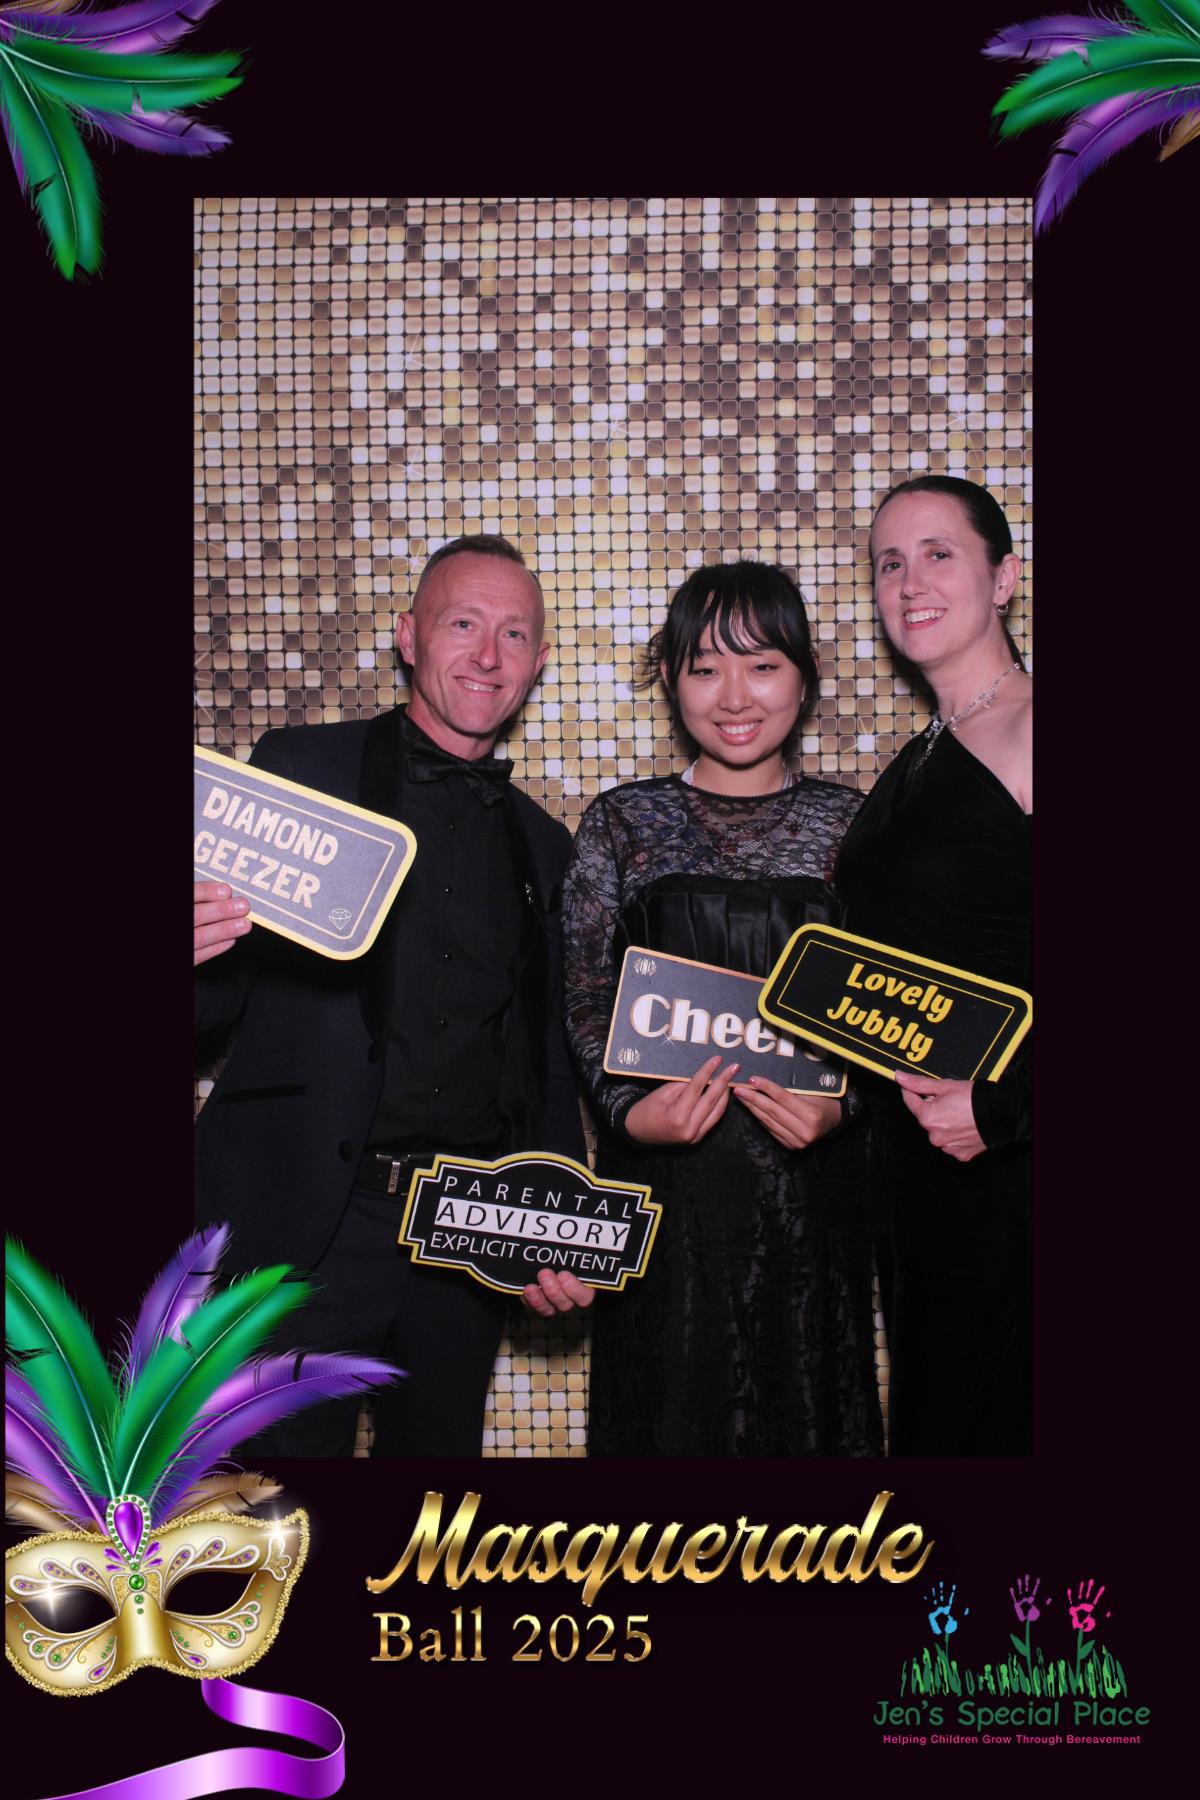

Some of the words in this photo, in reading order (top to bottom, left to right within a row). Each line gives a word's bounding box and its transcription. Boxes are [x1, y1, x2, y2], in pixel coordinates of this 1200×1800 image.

[202, 786, 339, 866] DIAMOND
[194, 831, 321, 909] GEEZER
[846, 963, 953, 1023] Lovely
[629, 993, 822, 1062] Chee
[826, 996, 934, 1062] Jubbly
[436, 1201, 629, 1247] ADVISORY
[444, 1176, 633, 1219] PARENTAL
[430, 1232, 520, 1259] EXPLICIT
[523, 1246, 621, 1273] CONTENT
